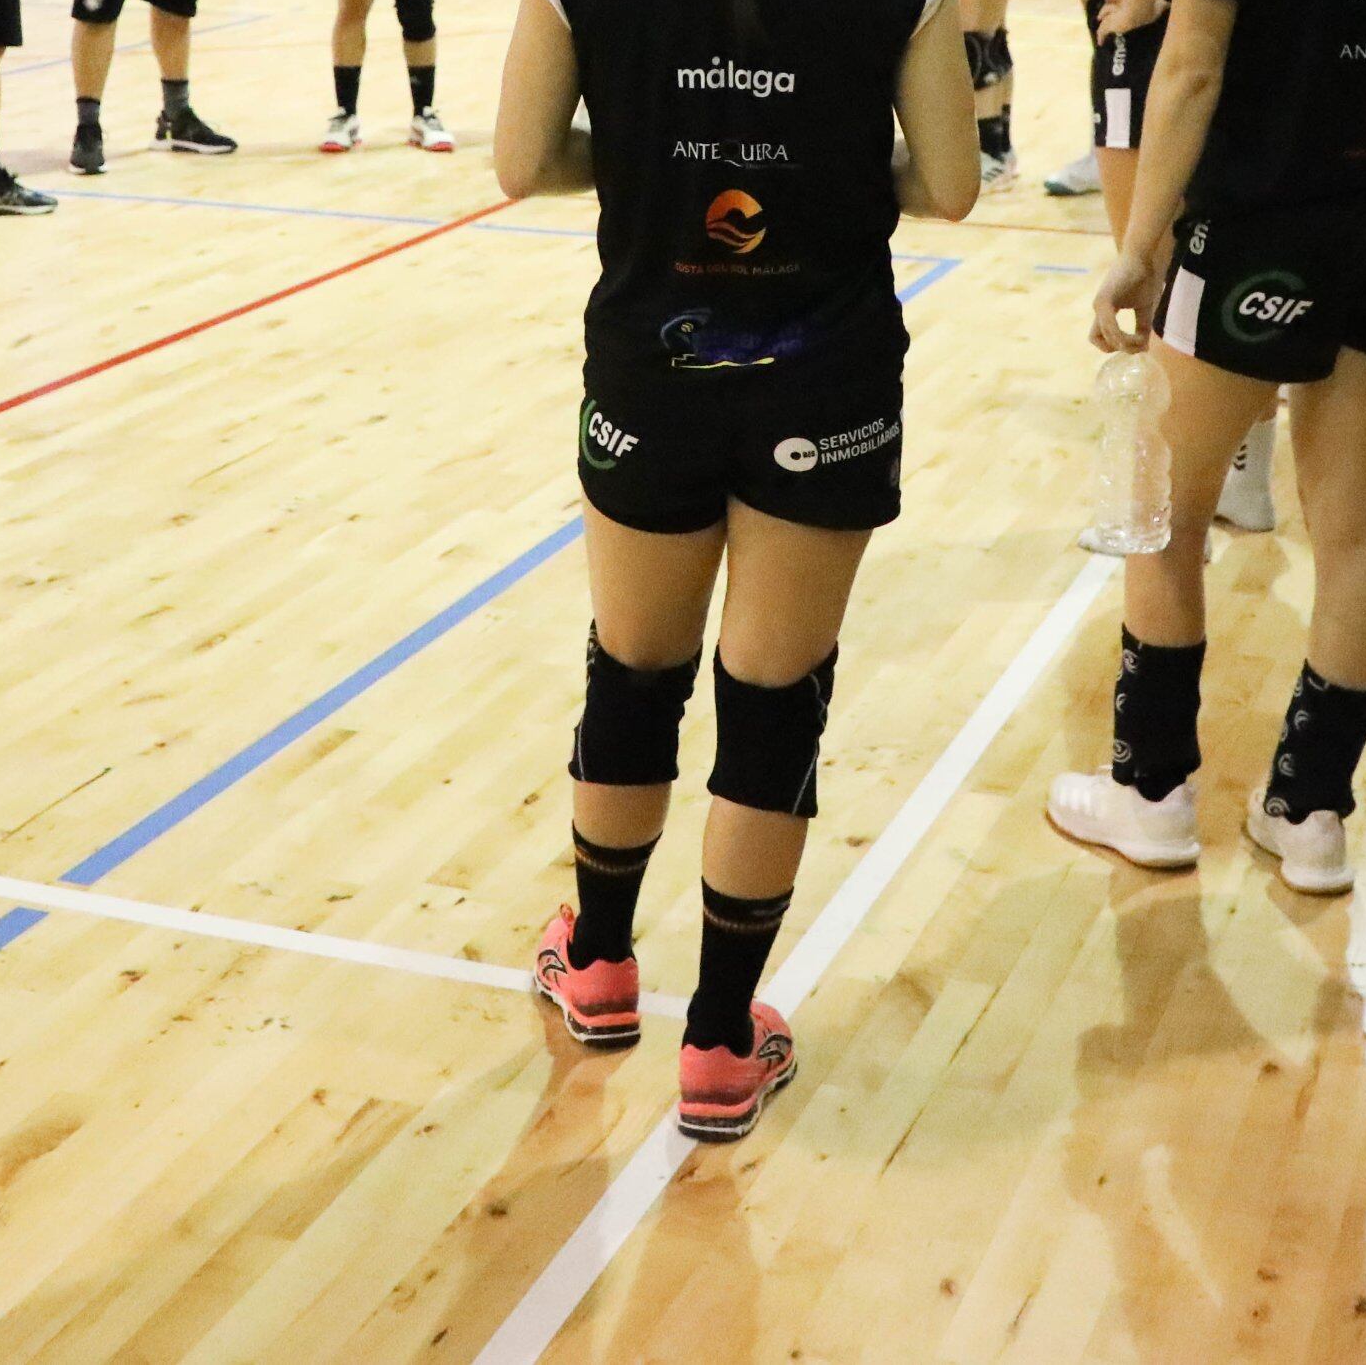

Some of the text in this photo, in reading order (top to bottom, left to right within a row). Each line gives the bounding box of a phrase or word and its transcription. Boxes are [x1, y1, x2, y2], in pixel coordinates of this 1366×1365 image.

[672, 141, 789, 166] ANTEUERA
[1238, 291, 1314, 325] CSIF
[588, 411, 639, 459] CSIF
[819, 417, 885, 451] SERVICIOS
[820, 421, 901, 465] INMOBILIARIOS
